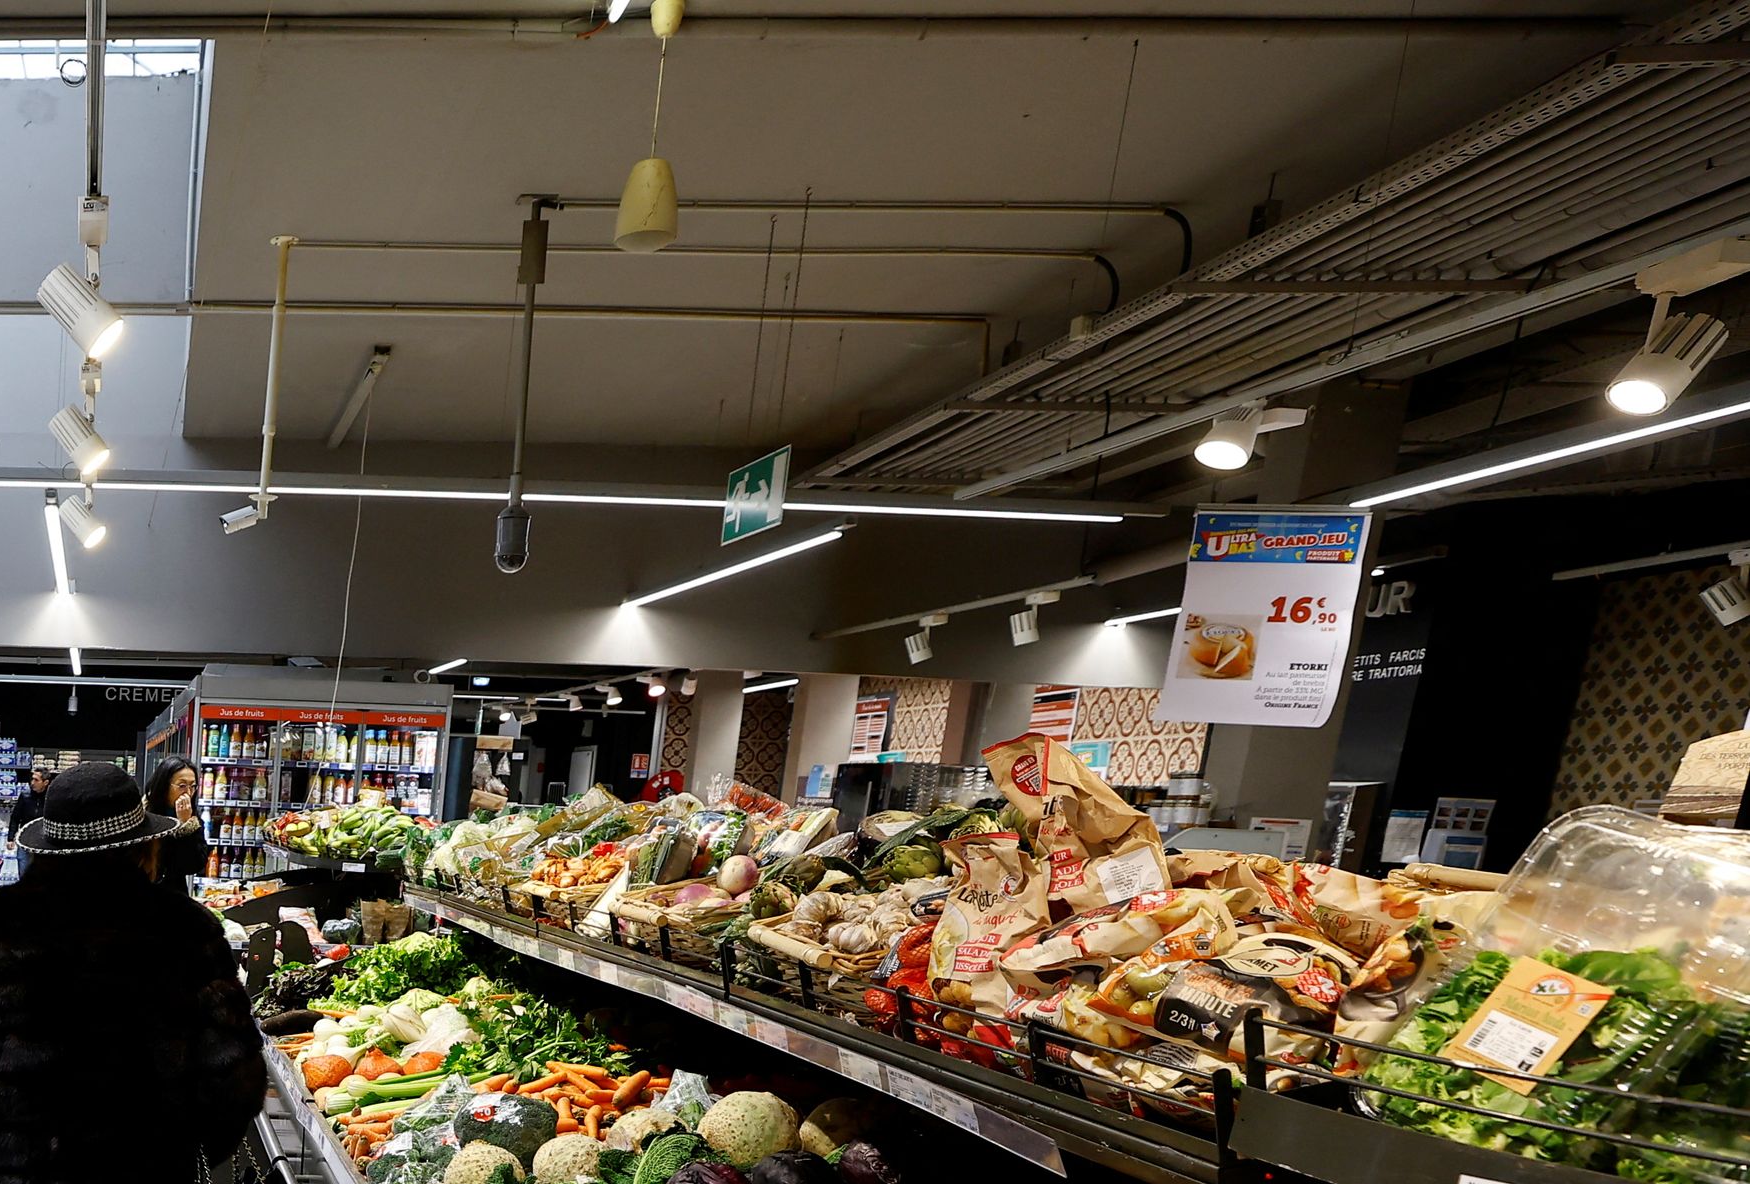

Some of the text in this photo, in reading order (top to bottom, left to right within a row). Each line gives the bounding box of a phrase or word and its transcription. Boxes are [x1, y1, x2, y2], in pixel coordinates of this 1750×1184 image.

[1263, 533, 1348, 549] GRAND JEU
[1389, 648, 1426, 664] FARCIS
[1289, 663, 1329, 671] ETORKI
[1368, 664, 1422, 680] TRATTORIA
[220, 708, 265, 718] Jus de fruits
[299, 711, 344, 721] Jus de fruits
[382, 714, 427, 724] Jus de fruits
[1177, 985, 1239, 1019] MINUTE
